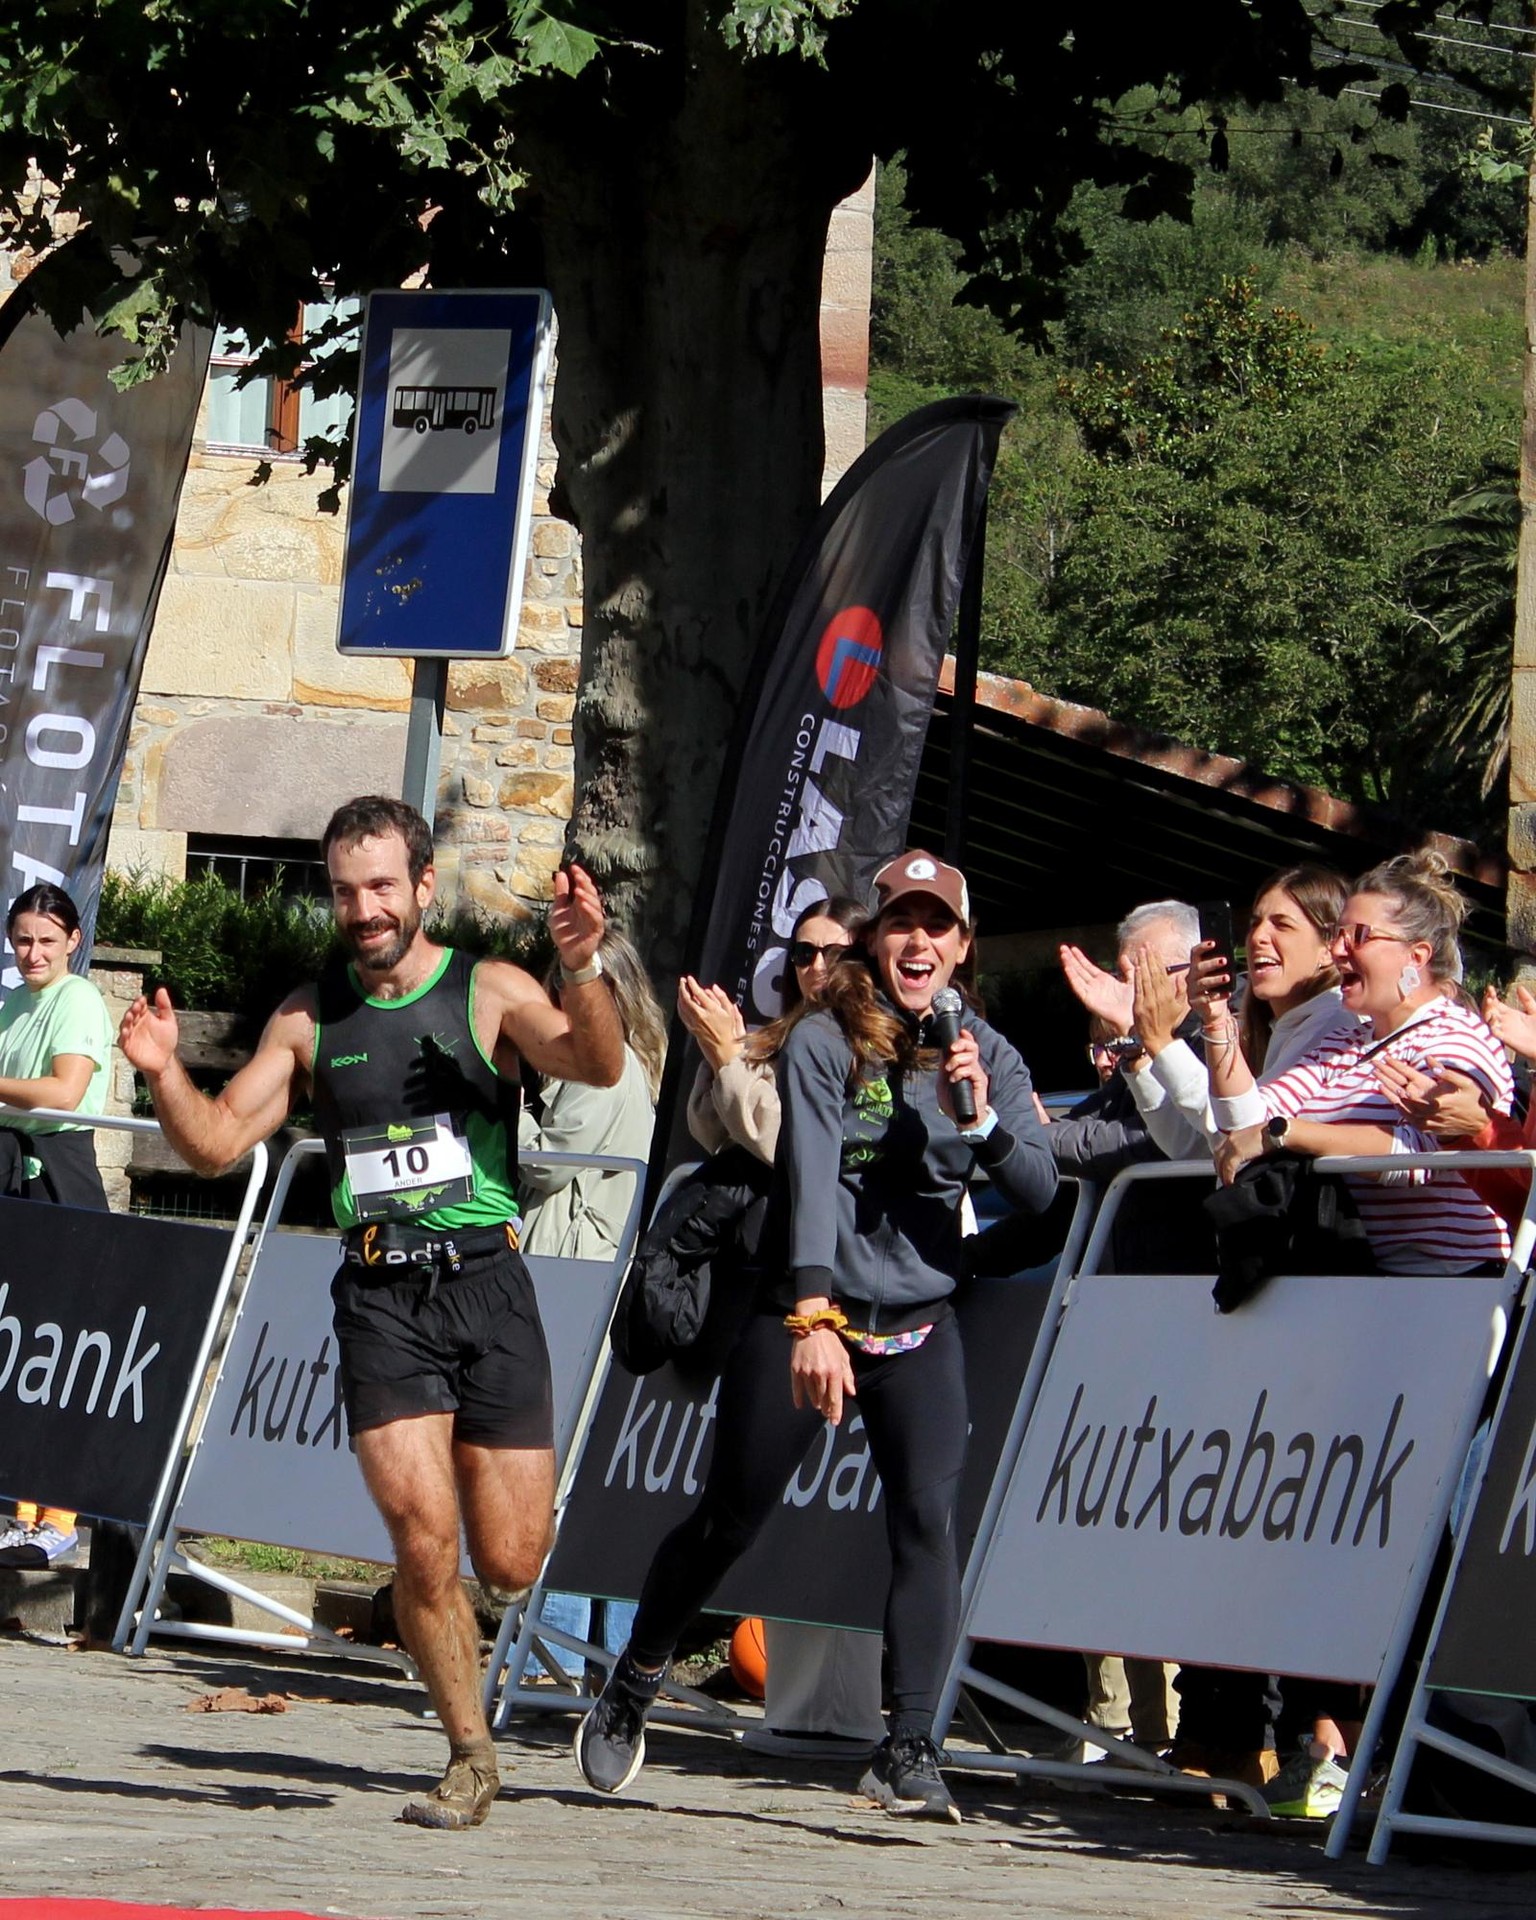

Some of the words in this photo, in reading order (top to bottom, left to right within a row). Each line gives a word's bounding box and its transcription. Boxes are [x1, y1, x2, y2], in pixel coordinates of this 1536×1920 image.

[746, 713, 816, 950] CONSTRUCCIONES
[382, 1146, 430, 1178] 10
[394, 1177, 424, 1189] ANDER
[1035, 1382, 1415, 1549] kutxabank
